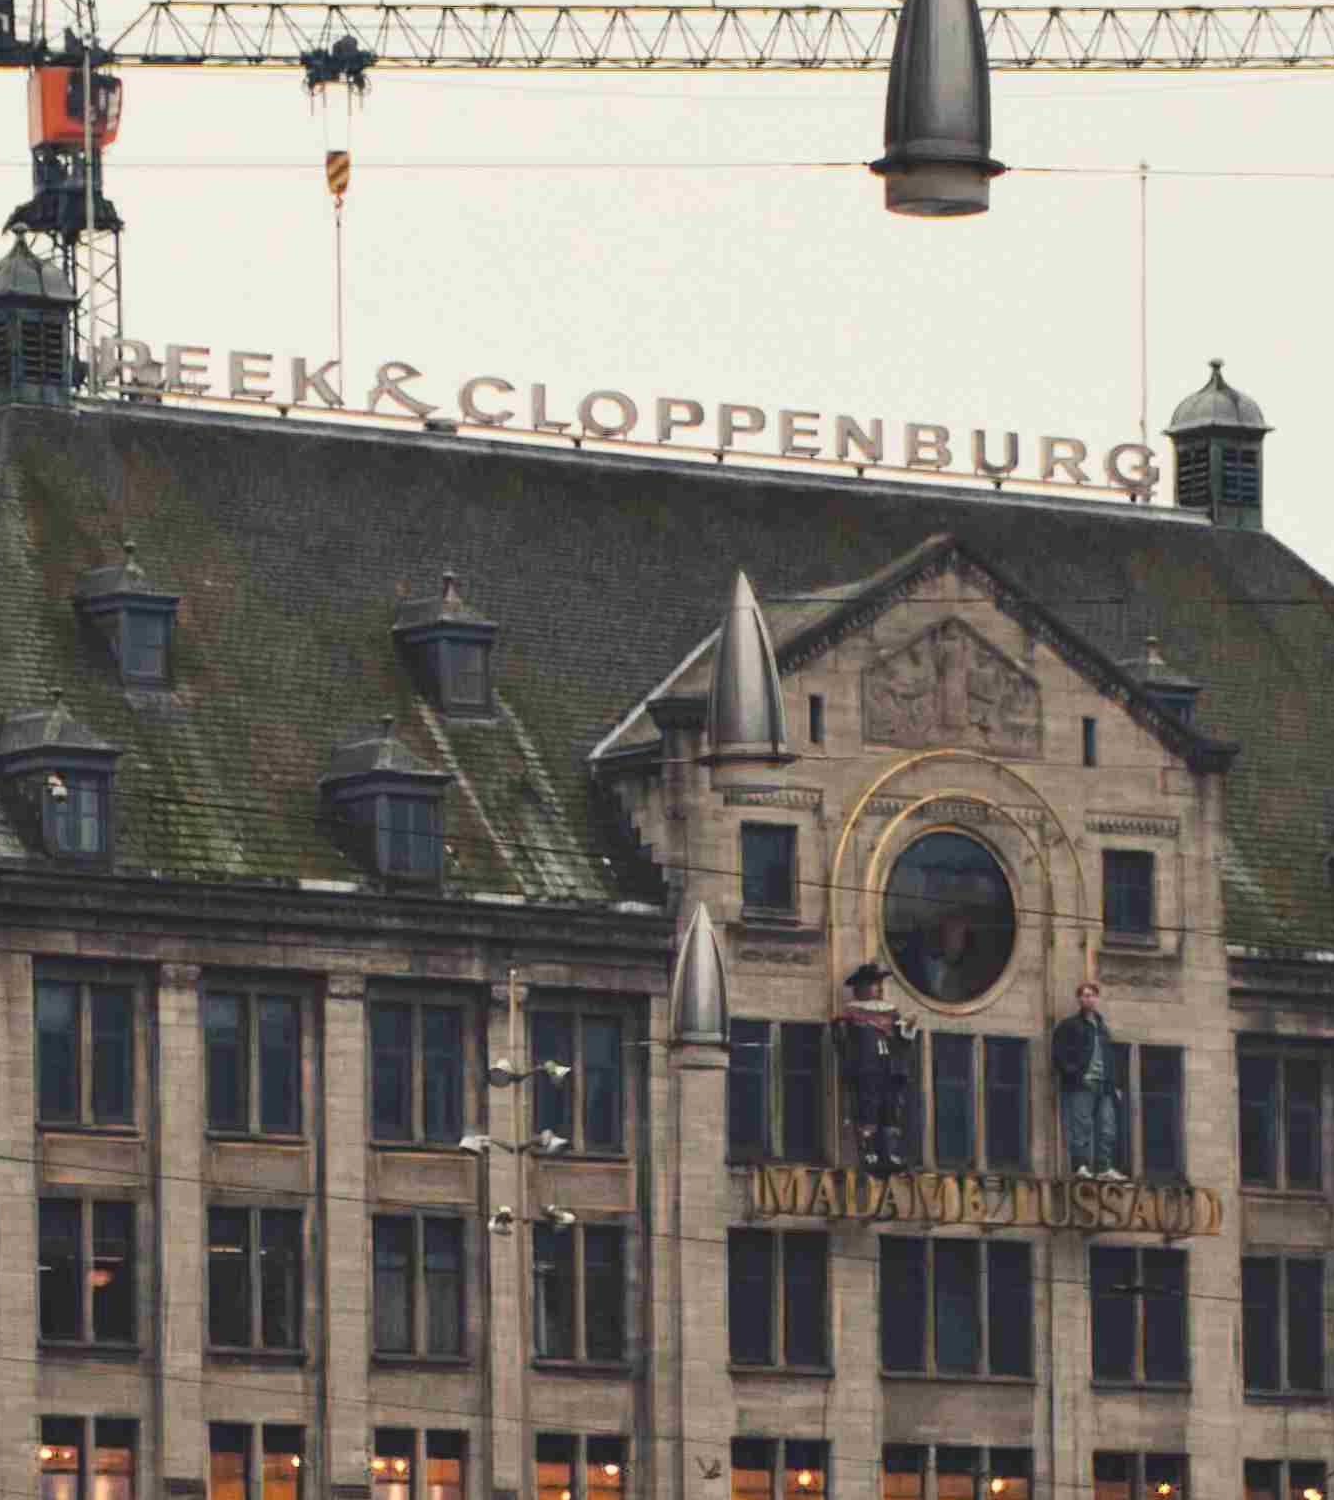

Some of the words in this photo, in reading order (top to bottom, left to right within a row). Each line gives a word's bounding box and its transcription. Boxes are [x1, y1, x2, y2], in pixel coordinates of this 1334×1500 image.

[99, 337, 344, 408] PEEK
[367, 360, 439, 416] &
[458, 376, 1160, 491] CLOPPENBURG
[753, 1168, 988, 1221] MADAME
